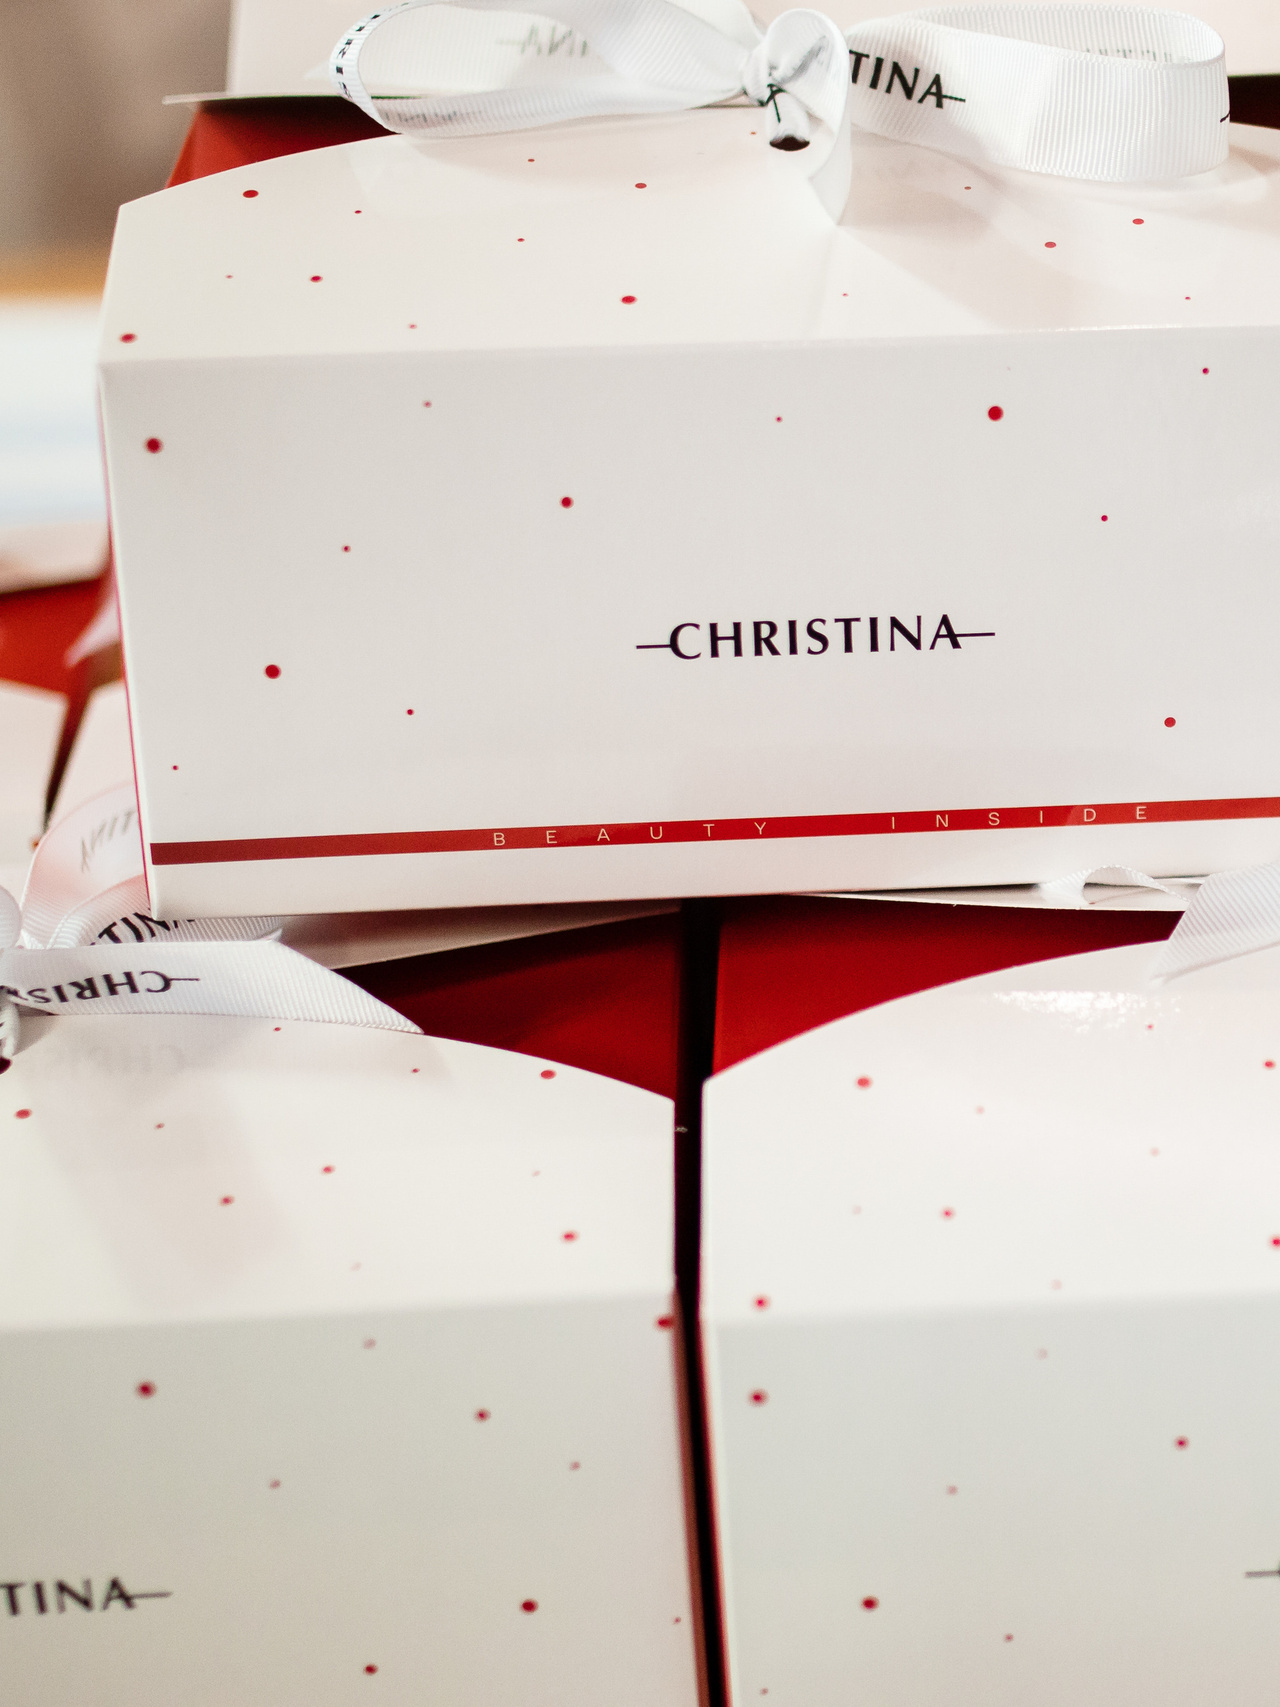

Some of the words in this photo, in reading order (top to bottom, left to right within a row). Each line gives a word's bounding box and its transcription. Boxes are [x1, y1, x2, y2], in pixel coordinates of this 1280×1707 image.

[669, 613, 963, 660] CHRISTINA
[492, 821, 767, 847] BEAUTY
[891, 805, 1148, 830] INSIDE
